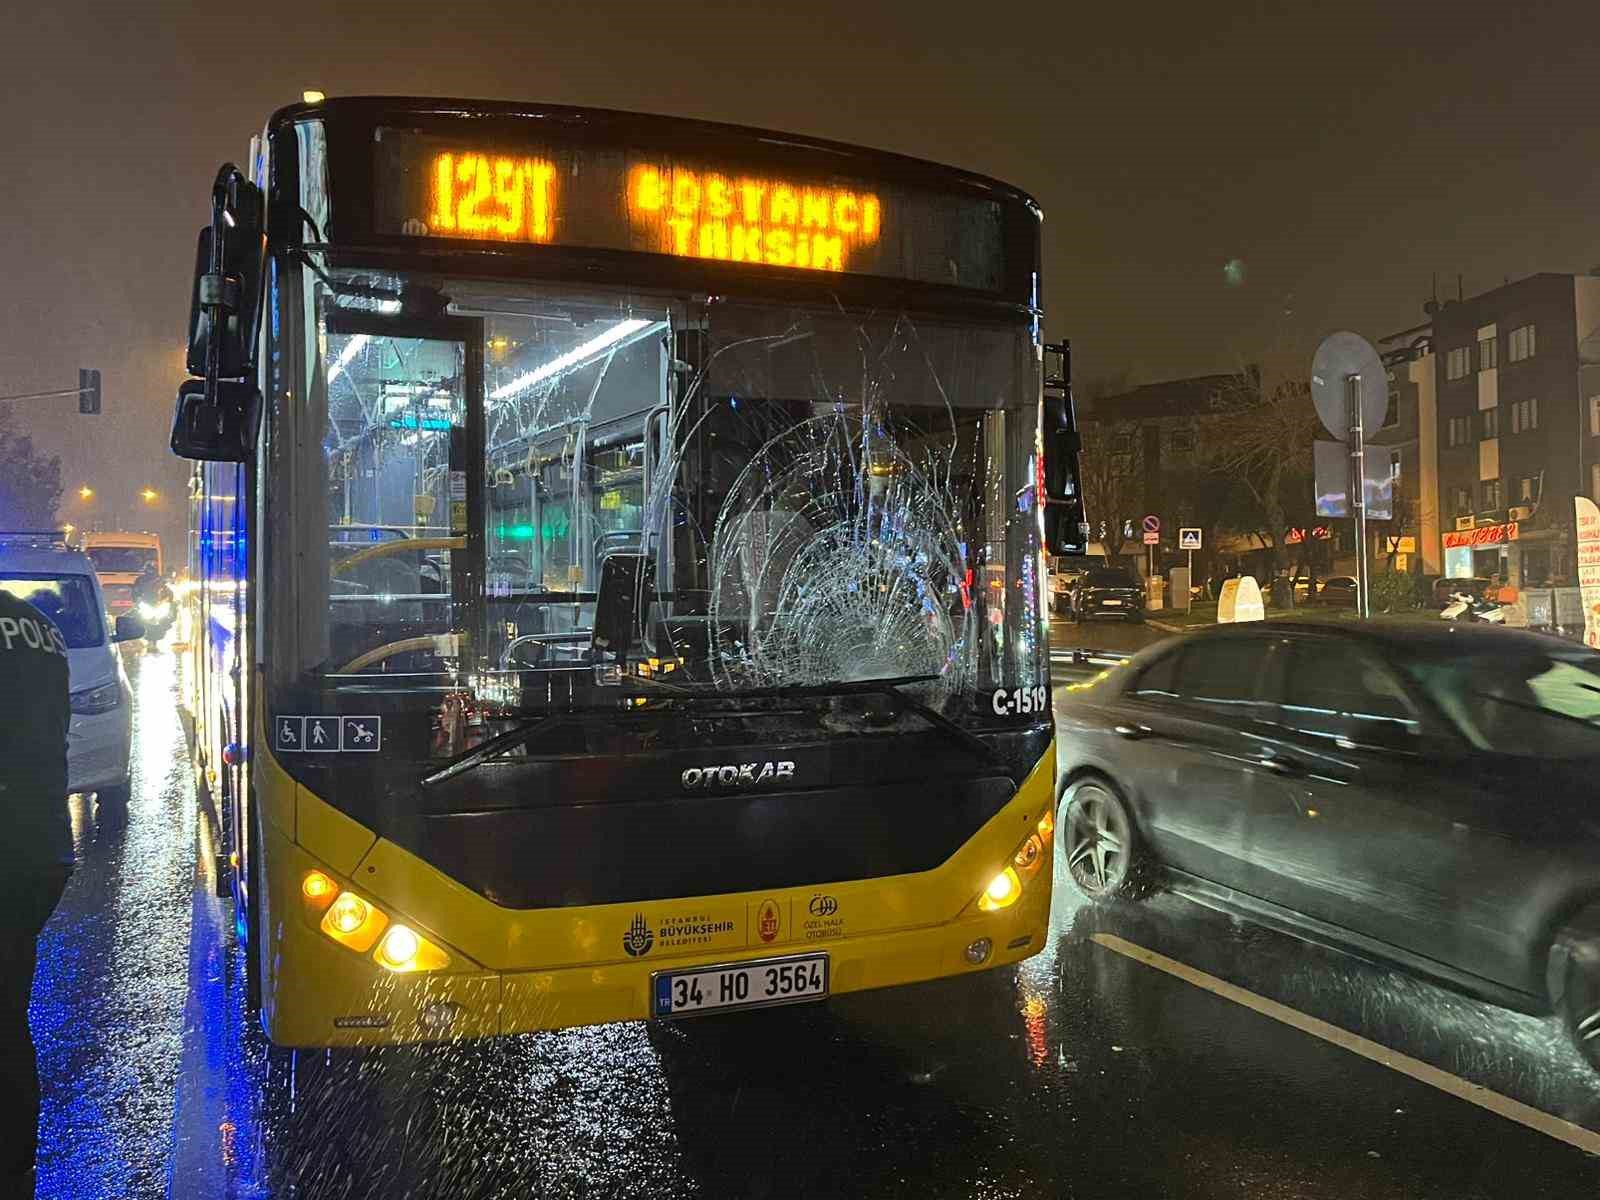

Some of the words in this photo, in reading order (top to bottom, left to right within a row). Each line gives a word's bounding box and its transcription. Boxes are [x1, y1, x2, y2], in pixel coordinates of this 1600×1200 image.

[630, 166, 881, 238] BOSTANCI
[992, 685, 1047, 715] C-1519
[681, 760, 796, 790] OTOKAR
[674, 978, 703, 1008] 34
[720, 972, 749, 1002] HO
[765, 964, 821, 996] 3564
